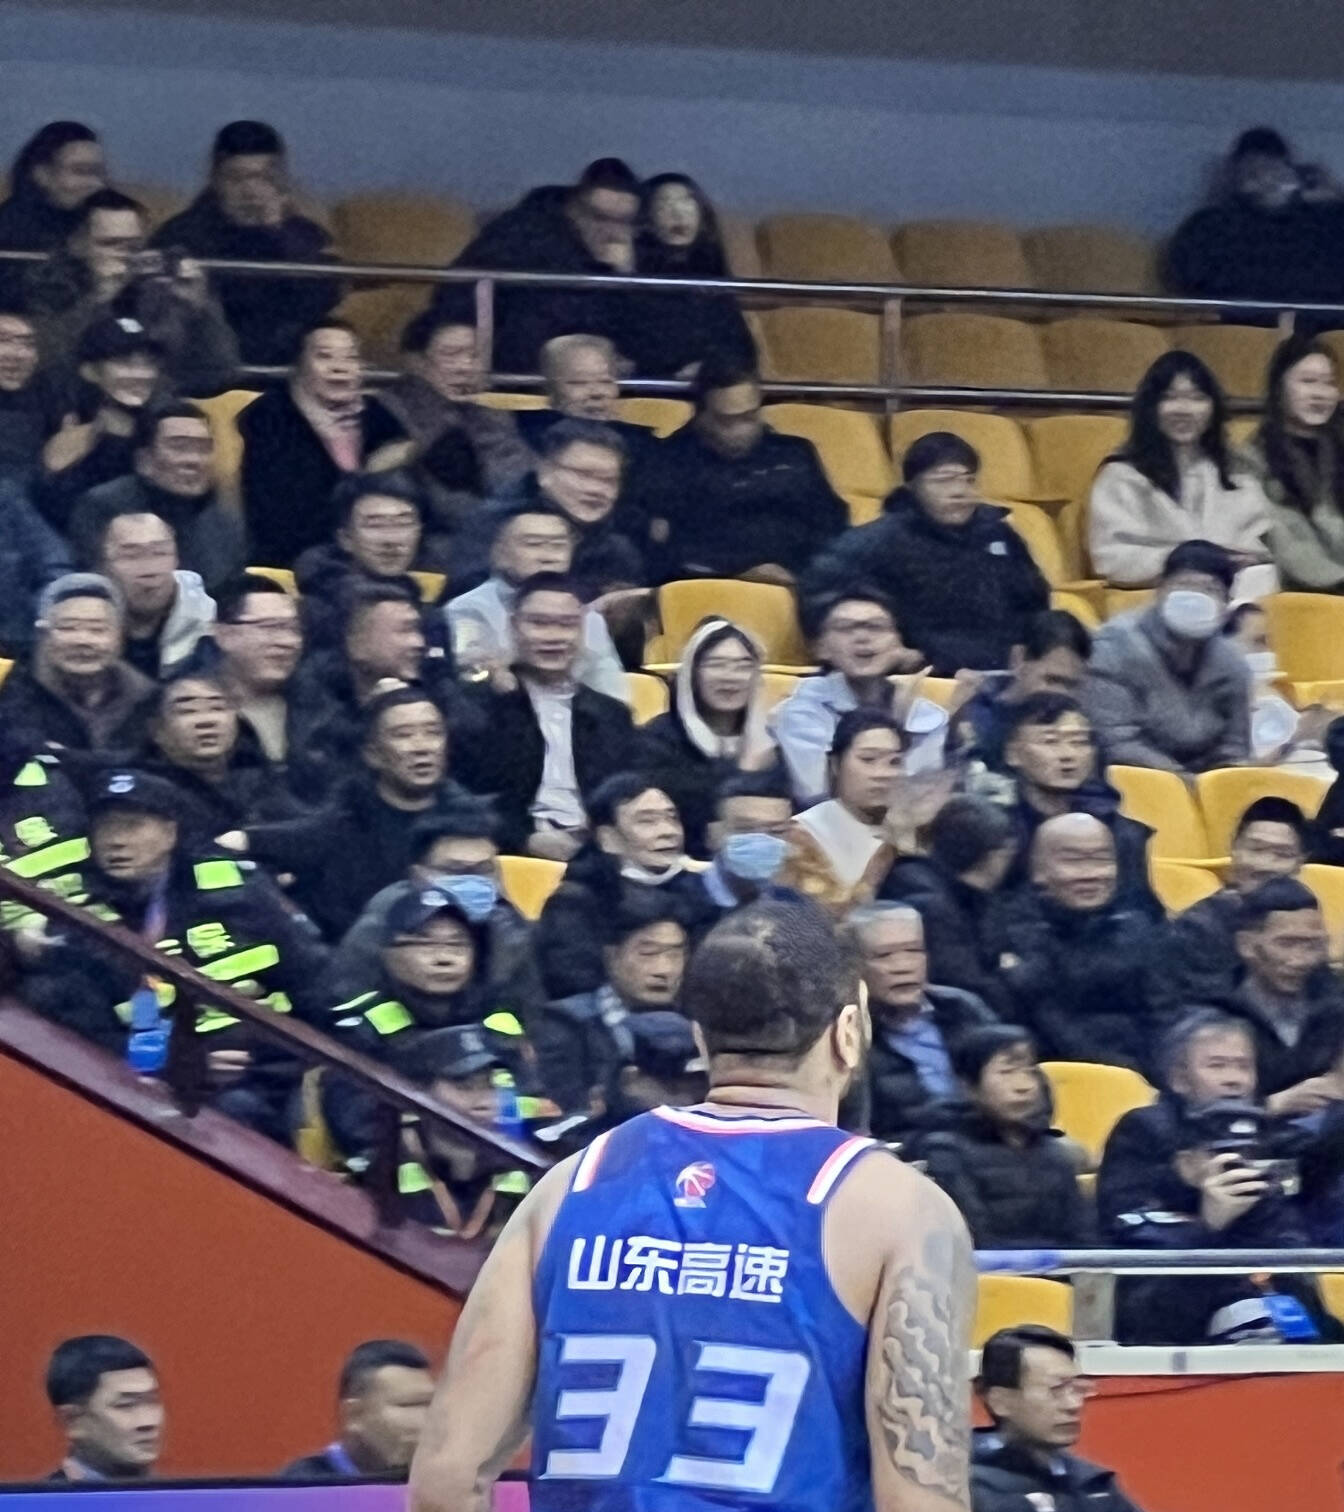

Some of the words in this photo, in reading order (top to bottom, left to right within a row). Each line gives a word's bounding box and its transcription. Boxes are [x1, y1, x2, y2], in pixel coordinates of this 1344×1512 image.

[568, 1236, 790, 1303] 山东高速
[540, 1334, 811, 1493] 33
